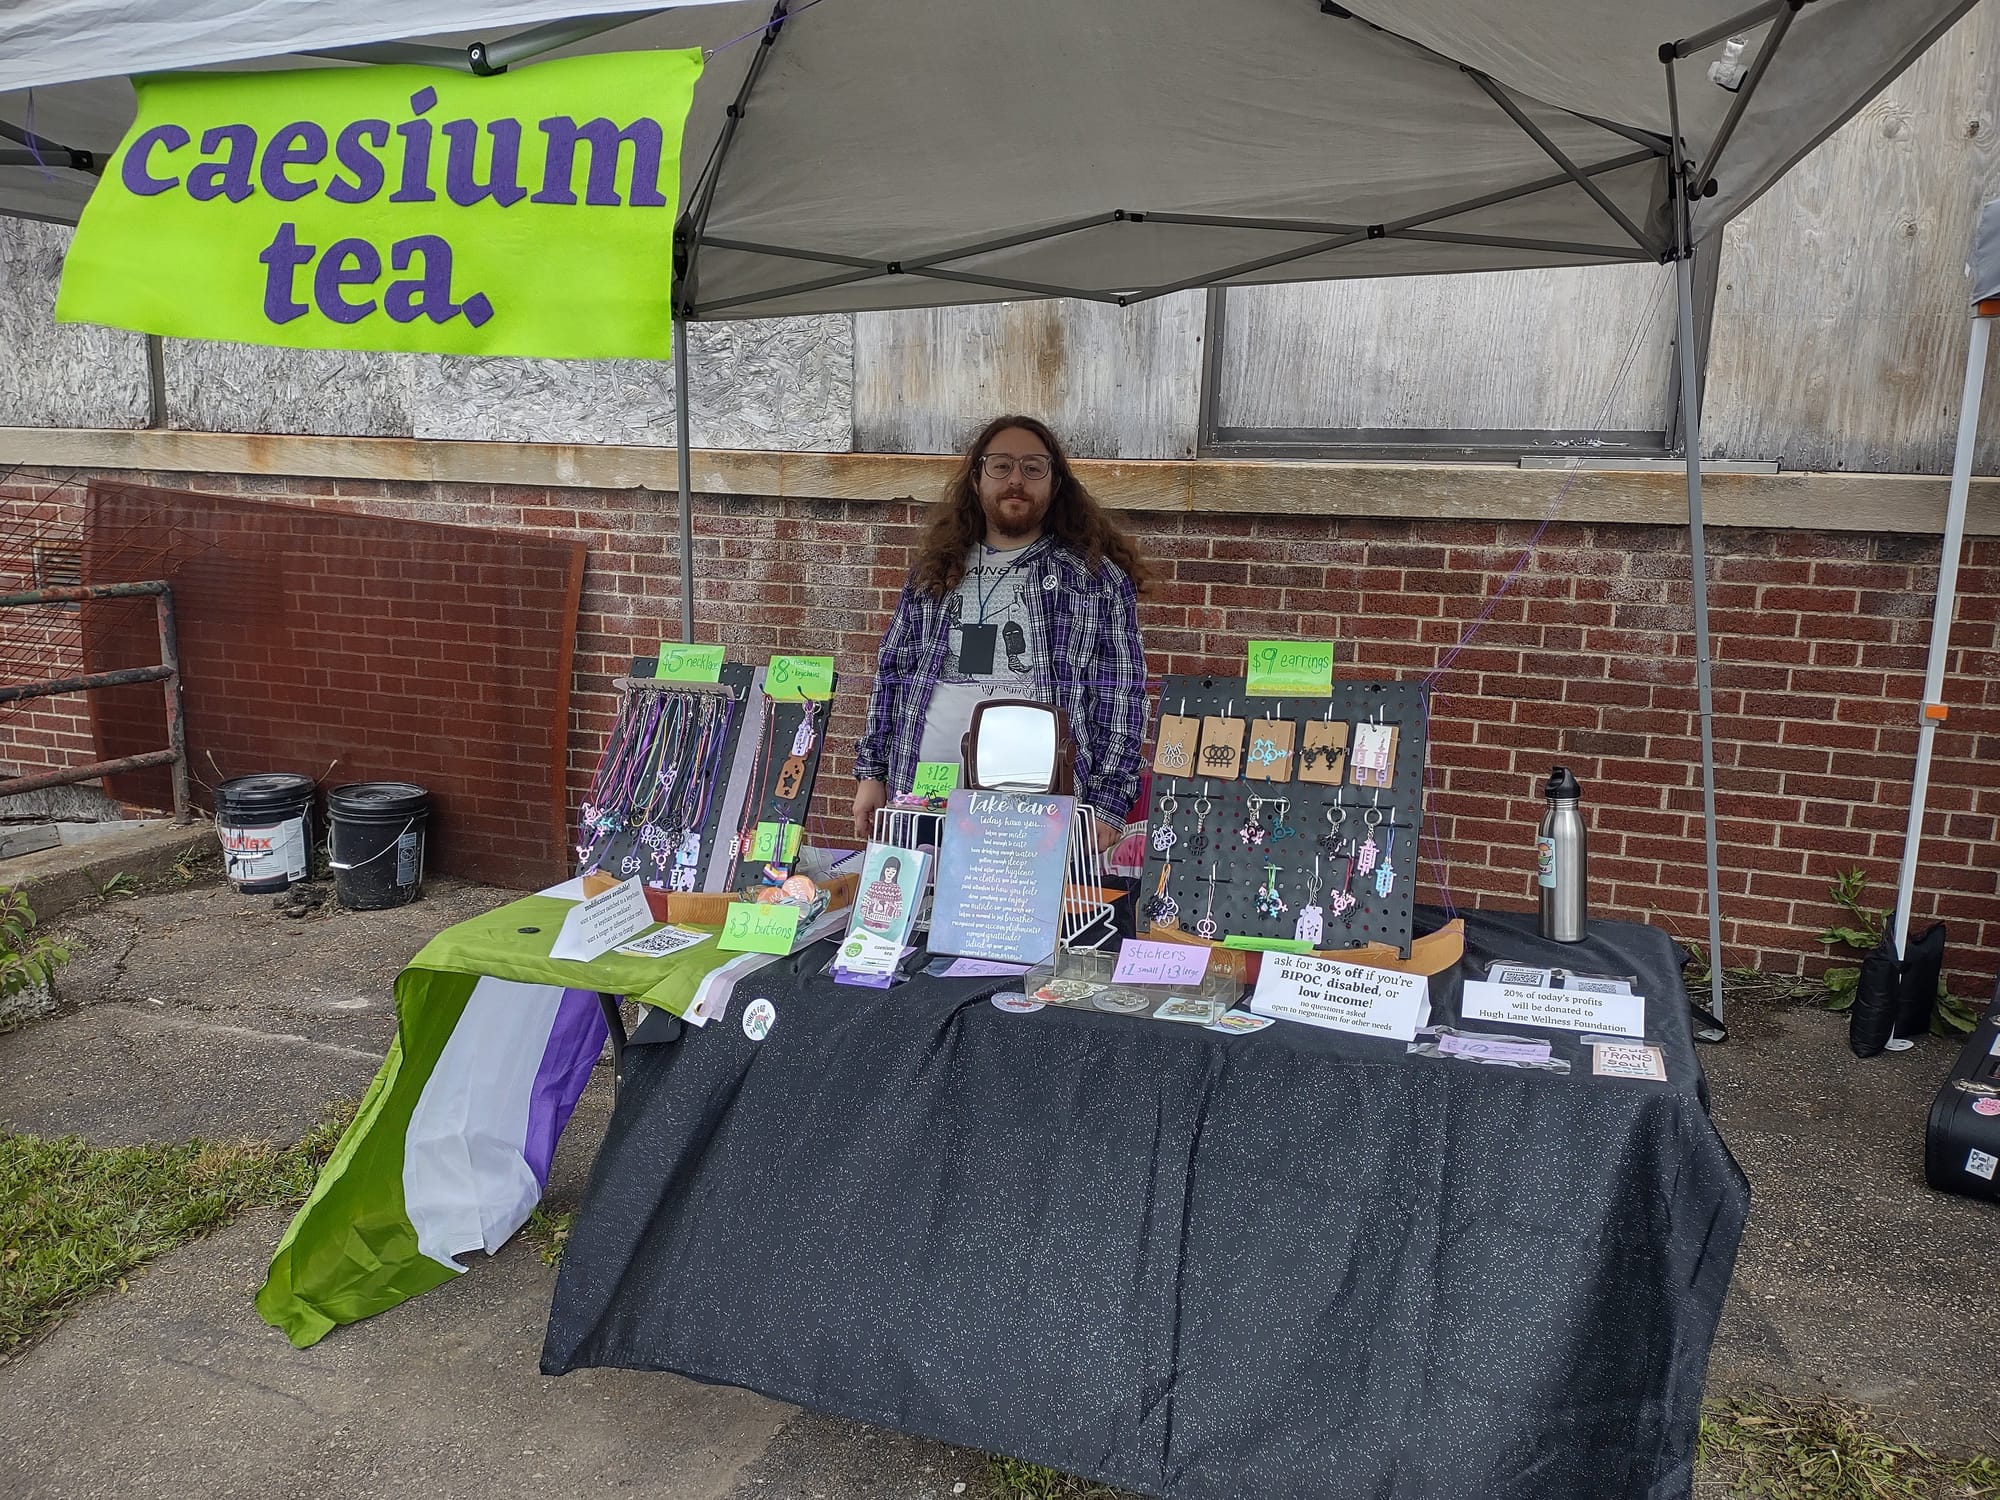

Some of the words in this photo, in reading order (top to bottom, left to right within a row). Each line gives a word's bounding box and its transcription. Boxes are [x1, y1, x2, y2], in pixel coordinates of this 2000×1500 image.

[120, 85, 668, 209] caesium
[258, 221, 495, 330] tea.
[662, 649, 688, 673] $5
[772, 658, 791, 684] $8
[1252, 647, 1279, 676] $9
[1280, 653, 1330, 675] earrings
[927, 764, 950, 781] $12
[968, 792, 1010, 815] take
[1017, 801, 1059, 816] care
[757, 832, 774, 852] $3
[729, 911, 751, 939] $3
[754, 917, 793, 940] buttons
[1127, 944, 1187, 961] stickers
[1121, 963, 1137, 976] $1
[1136, 965, 1158, 975] small
[1167, 964, 1182, 979] $3
[1273, 956, 1293, 967] ask
[1295, 958, 1313, 970] for
[1314, 962, 1342, 976] 30%
[1344, 966, 1363, 979] off
[1365, 970, 1376, 981] if
[1377, 973, 1414, 989] you're
[1280, 969, 1324, 987] BIPOC,
[1326, 977, 1382, 997] disabled,
[1385, 988, 1400, 999] or
[1298, 985, 1321, 999] low
[1323, 991, 1374, 1009] income!
[1503, 989, 1524, 998] 20%
[1525, 990, 1536, 999] of
[1537, 992, 1570, 1003] today's
[1572, 996, 1604, 1008] profits
[1511, 1001, 1529, 1010] will
[1531, 1003, 1543, 1011] be
[1544, 1004, 1582, 1016] donated
[1584, 1008, 1594, 1017] to
[1271, 1003, 1289, 1013] open
[1289, 1006, 1298, 1014] to
[1298, 1008, 1338, 1023] negotiation
[1339, 1014, 1351, 1024] for
[1351, 1017, 1370, 1028] other
[1371, 1022, 1393, 1031] needs
[1310, 1002, 1345, 1015] questions
[1345, 1009, 1367, 1018] asked
[1479, 1009, 1505, 1020] Hugh
[1507, 1012, 1529, 1022] Lane
[1531, 1015, 1572, 1027] Wellness
[1573, 1018, 1627, 1033] Foundation
[1599, 1050, 1653, 1062] TRANS
